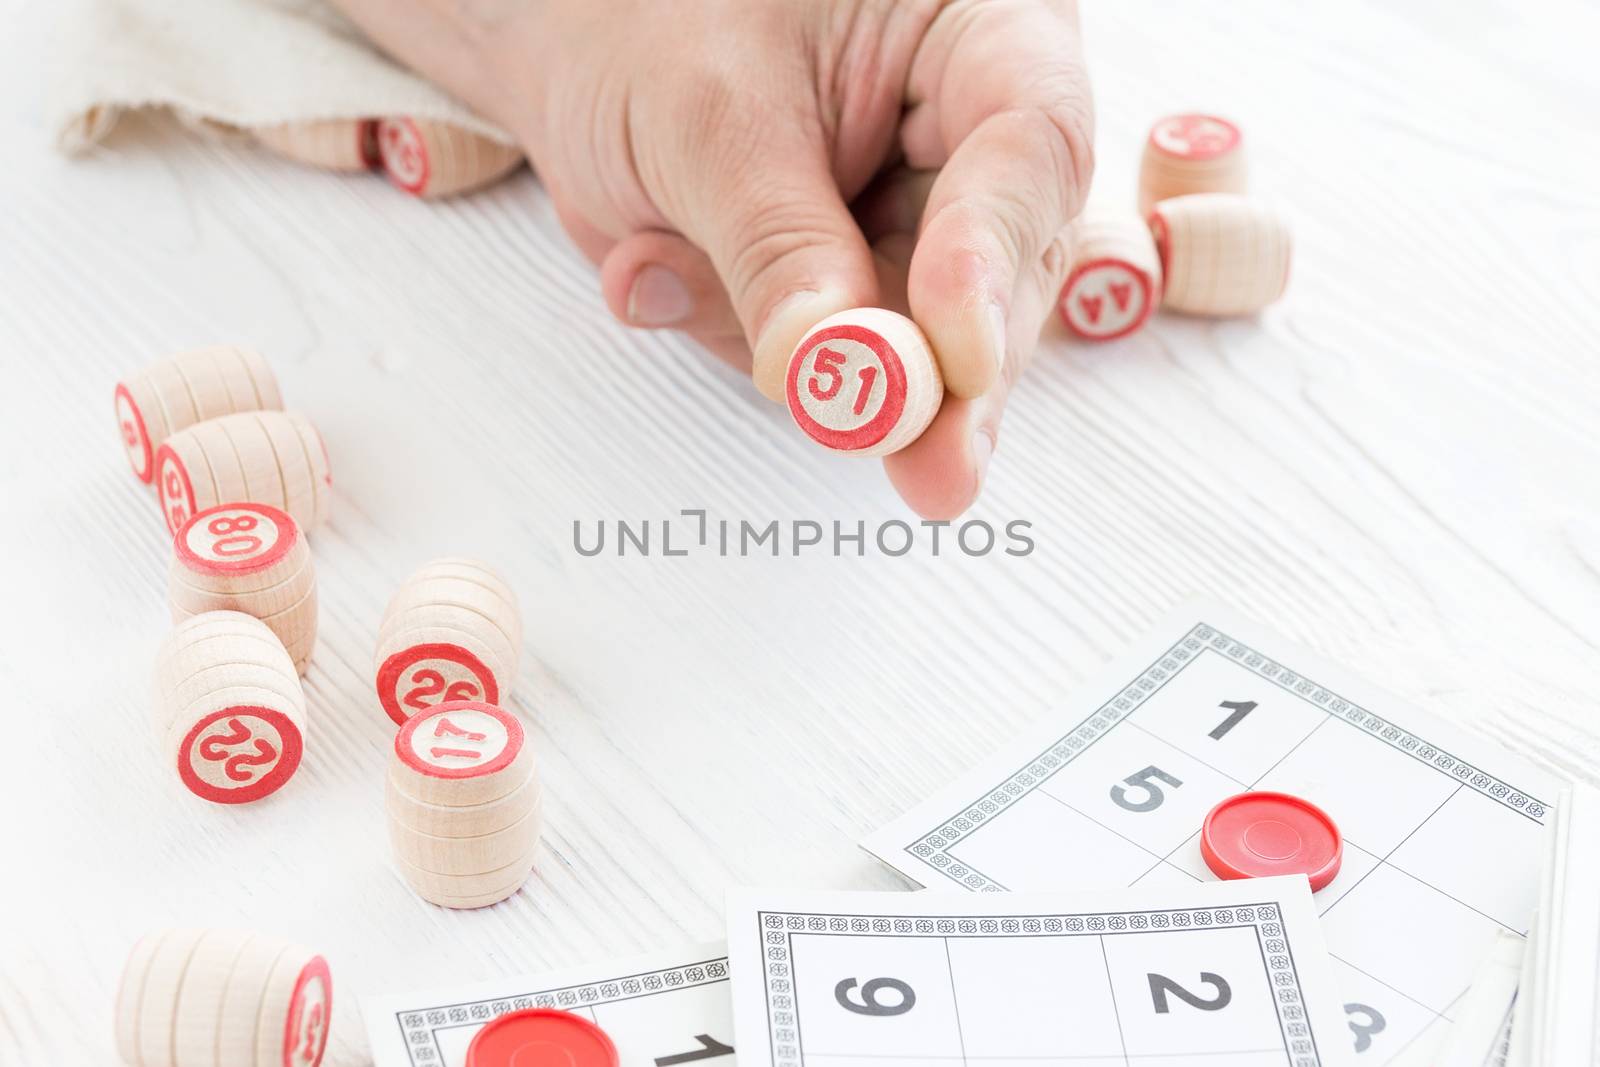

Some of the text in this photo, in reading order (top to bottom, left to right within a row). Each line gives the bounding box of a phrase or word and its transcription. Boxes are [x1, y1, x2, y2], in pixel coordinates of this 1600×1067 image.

[808, 347, 878, 416] 51
[208, 515, 262, 556] 80
[430, 718, 487, 758] 17
[1207, 700, 1259, 741] 1
[199, 718, 277, 782] 22
[1110, 764, 1184, 813] 5
[834, 976, 917, 1017] 9
[1146, 972, 1232, 1014] 2
[653, 1033, 735, 1067] 1
